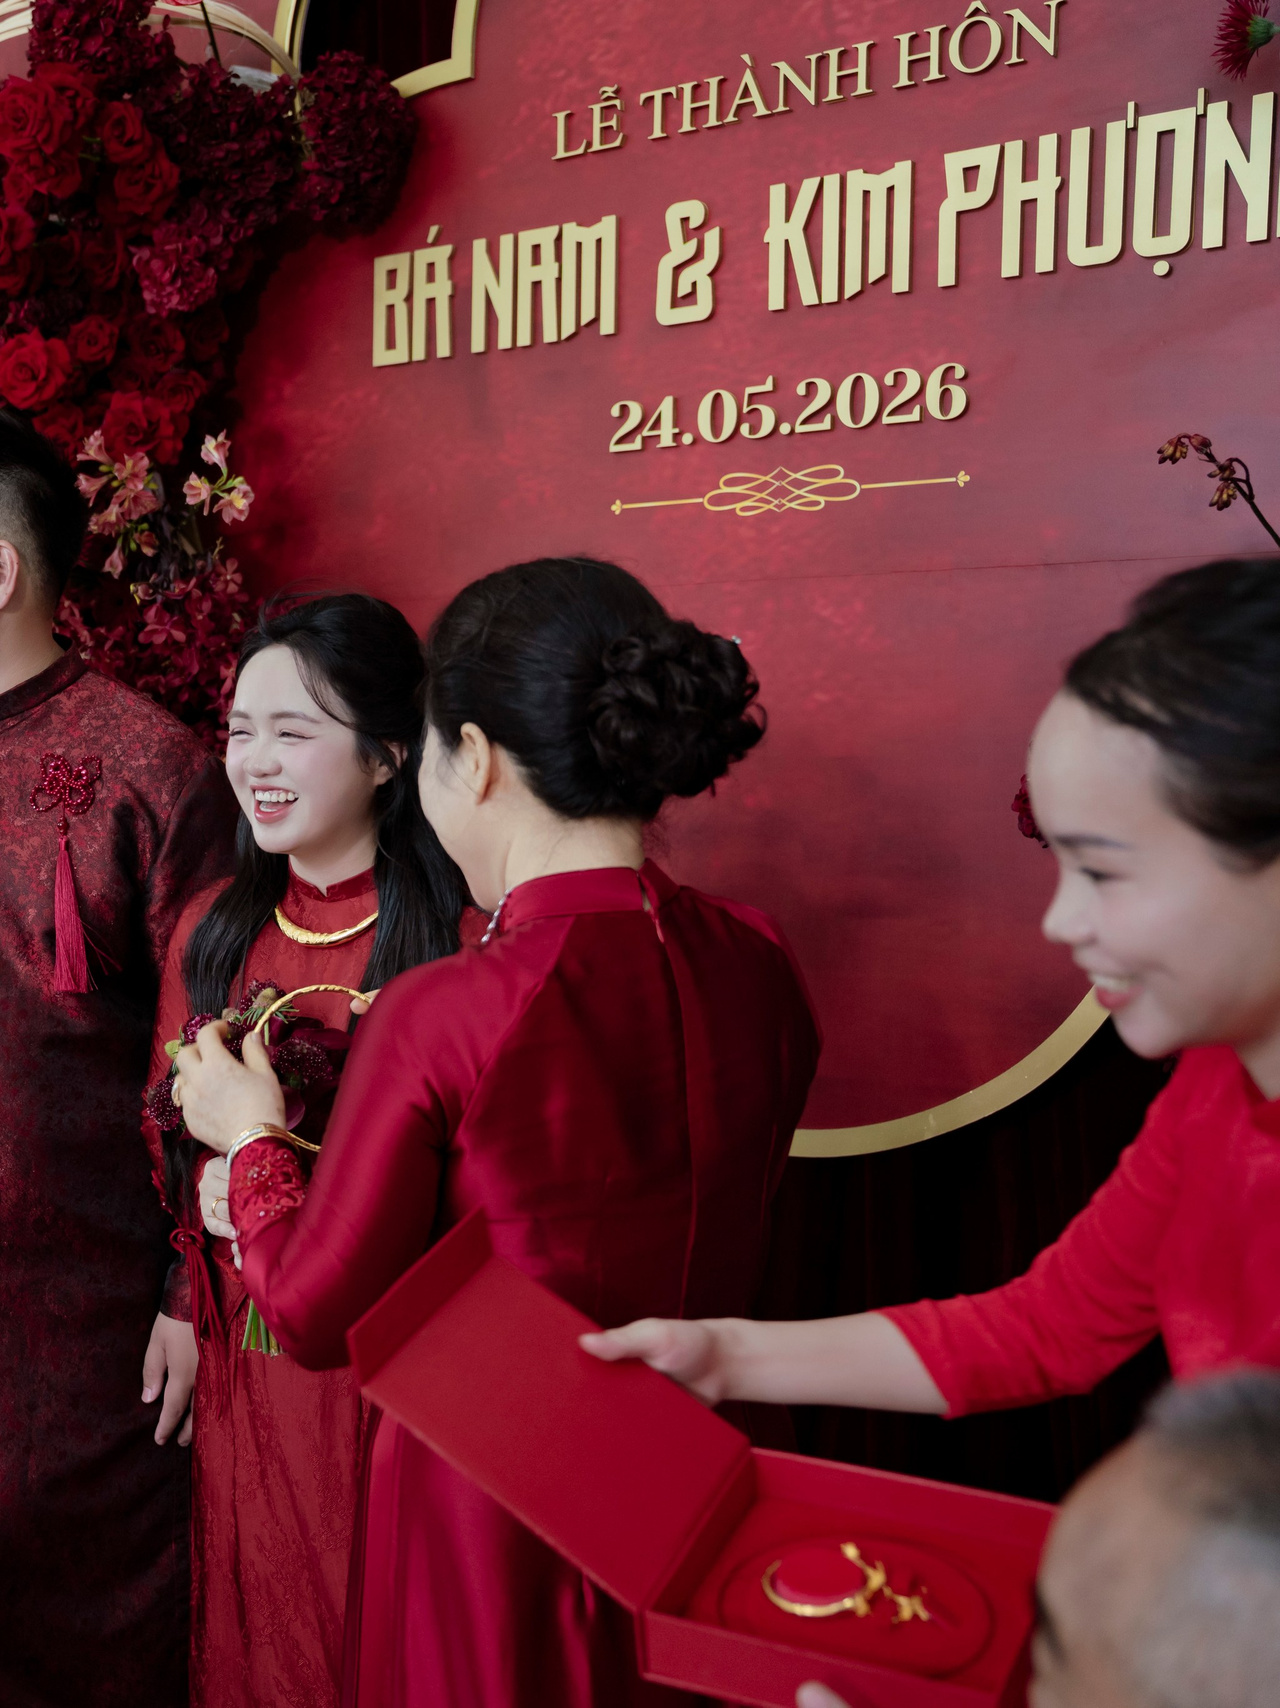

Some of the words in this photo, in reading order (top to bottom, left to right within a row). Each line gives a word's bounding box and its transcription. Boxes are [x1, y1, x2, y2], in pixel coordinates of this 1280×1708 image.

[550, 83, 626, 161] LỄ
[638, 40, 876, 142] THÀNH
[891, 0, 1068, 90] HÔN
[372, 225, 456, 368] BÁ
[470, 214, 619, 355] NAM
[655, 198, 722, 328] &
[762, 159, 914, 312] KIM
[937, 87, 1280, 289] PHƯỢN
[608, 361, 969, 455] 24.05.2026
